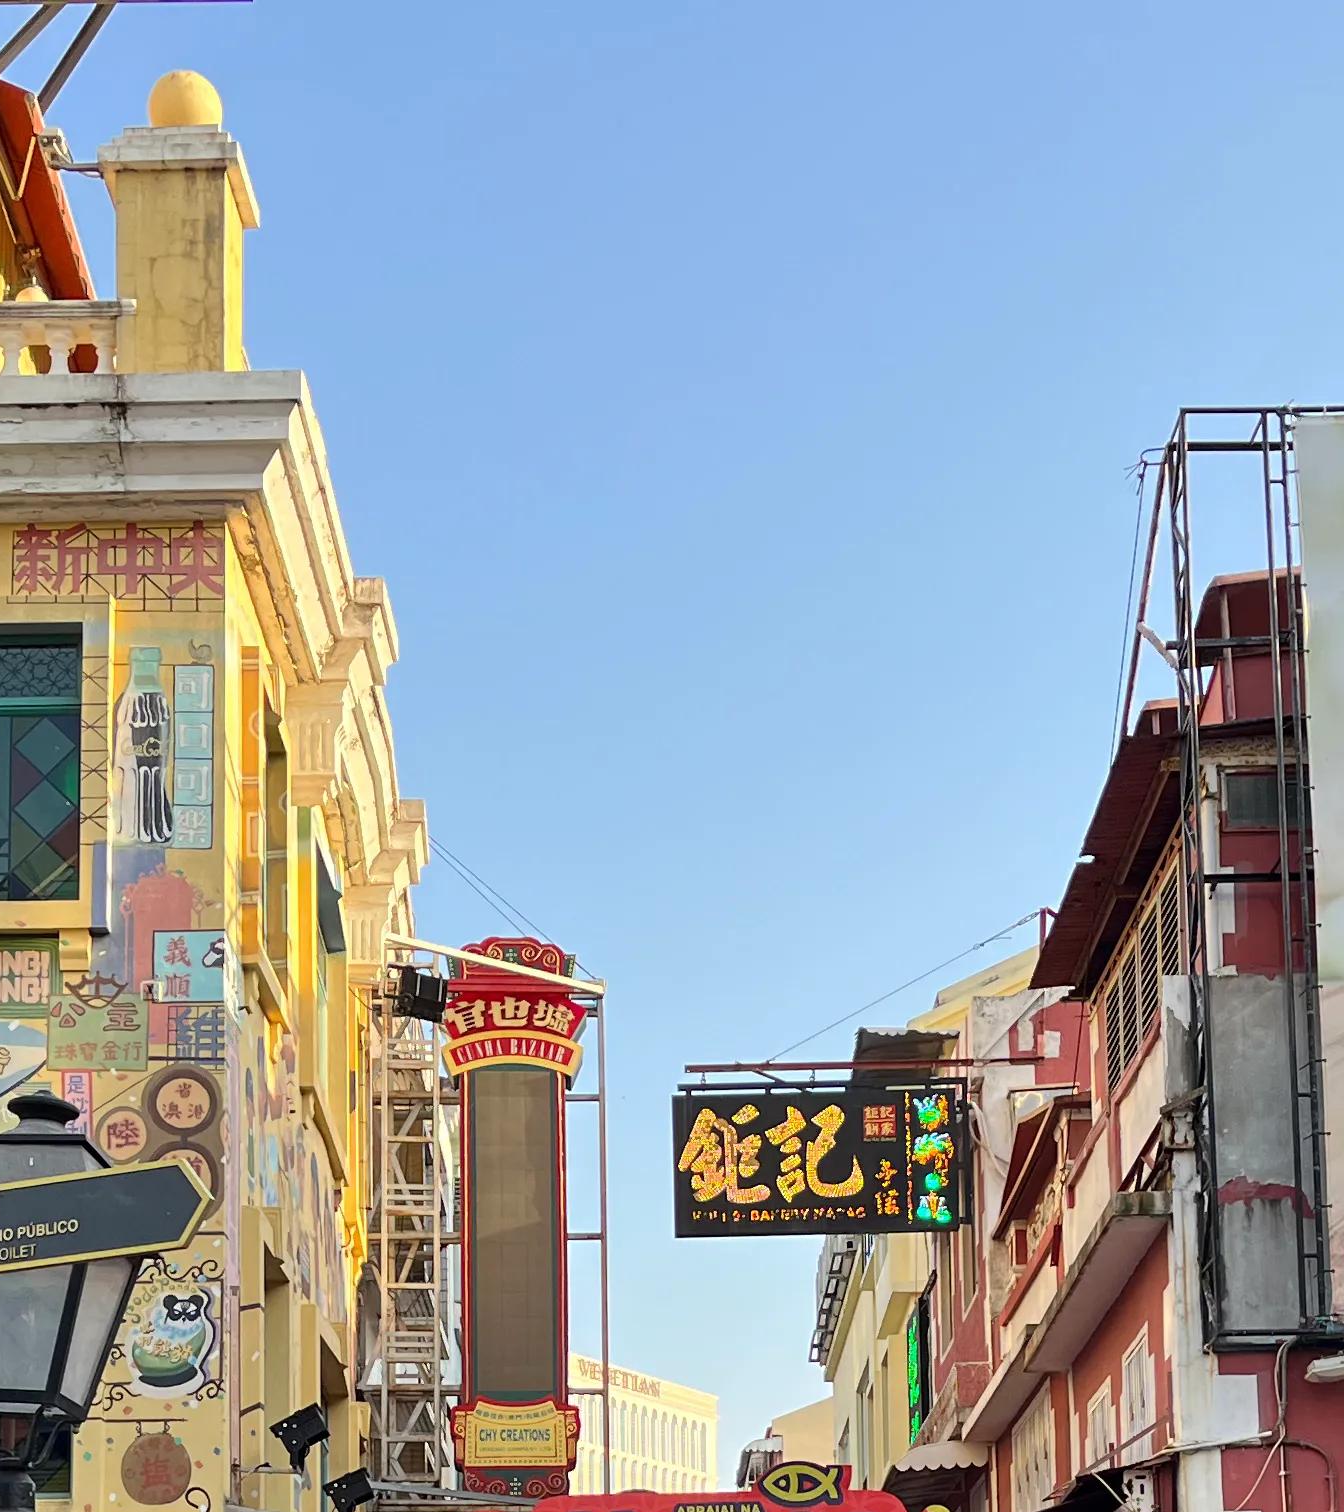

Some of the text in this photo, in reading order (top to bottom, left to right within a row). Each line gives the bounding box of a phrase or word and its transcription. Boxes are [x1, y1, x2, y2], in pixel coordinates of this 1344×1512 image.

[15, 519, 224, 596] 新中央
[175, 667, 212, 846] 可口可樂
[163, 935, 193, 998] 義順
[51, 1003, 141, 1031] 公主
[444, 996, 575, 1035] 官也墟
[54, 1041, 144, 1062] 珠寶金行
[456, 1038, 565, 1063] CUNHA BAZAAR
[107, 1118, 141, 1150] 陸
[678, 1103, 865, 1204] 鉅記
[17, 1218, 79, 1240] PÚBLICO
[578, 1359, 662, 1398] VEETIAN
[500, 1428, 551, 1442] CREATIONS
